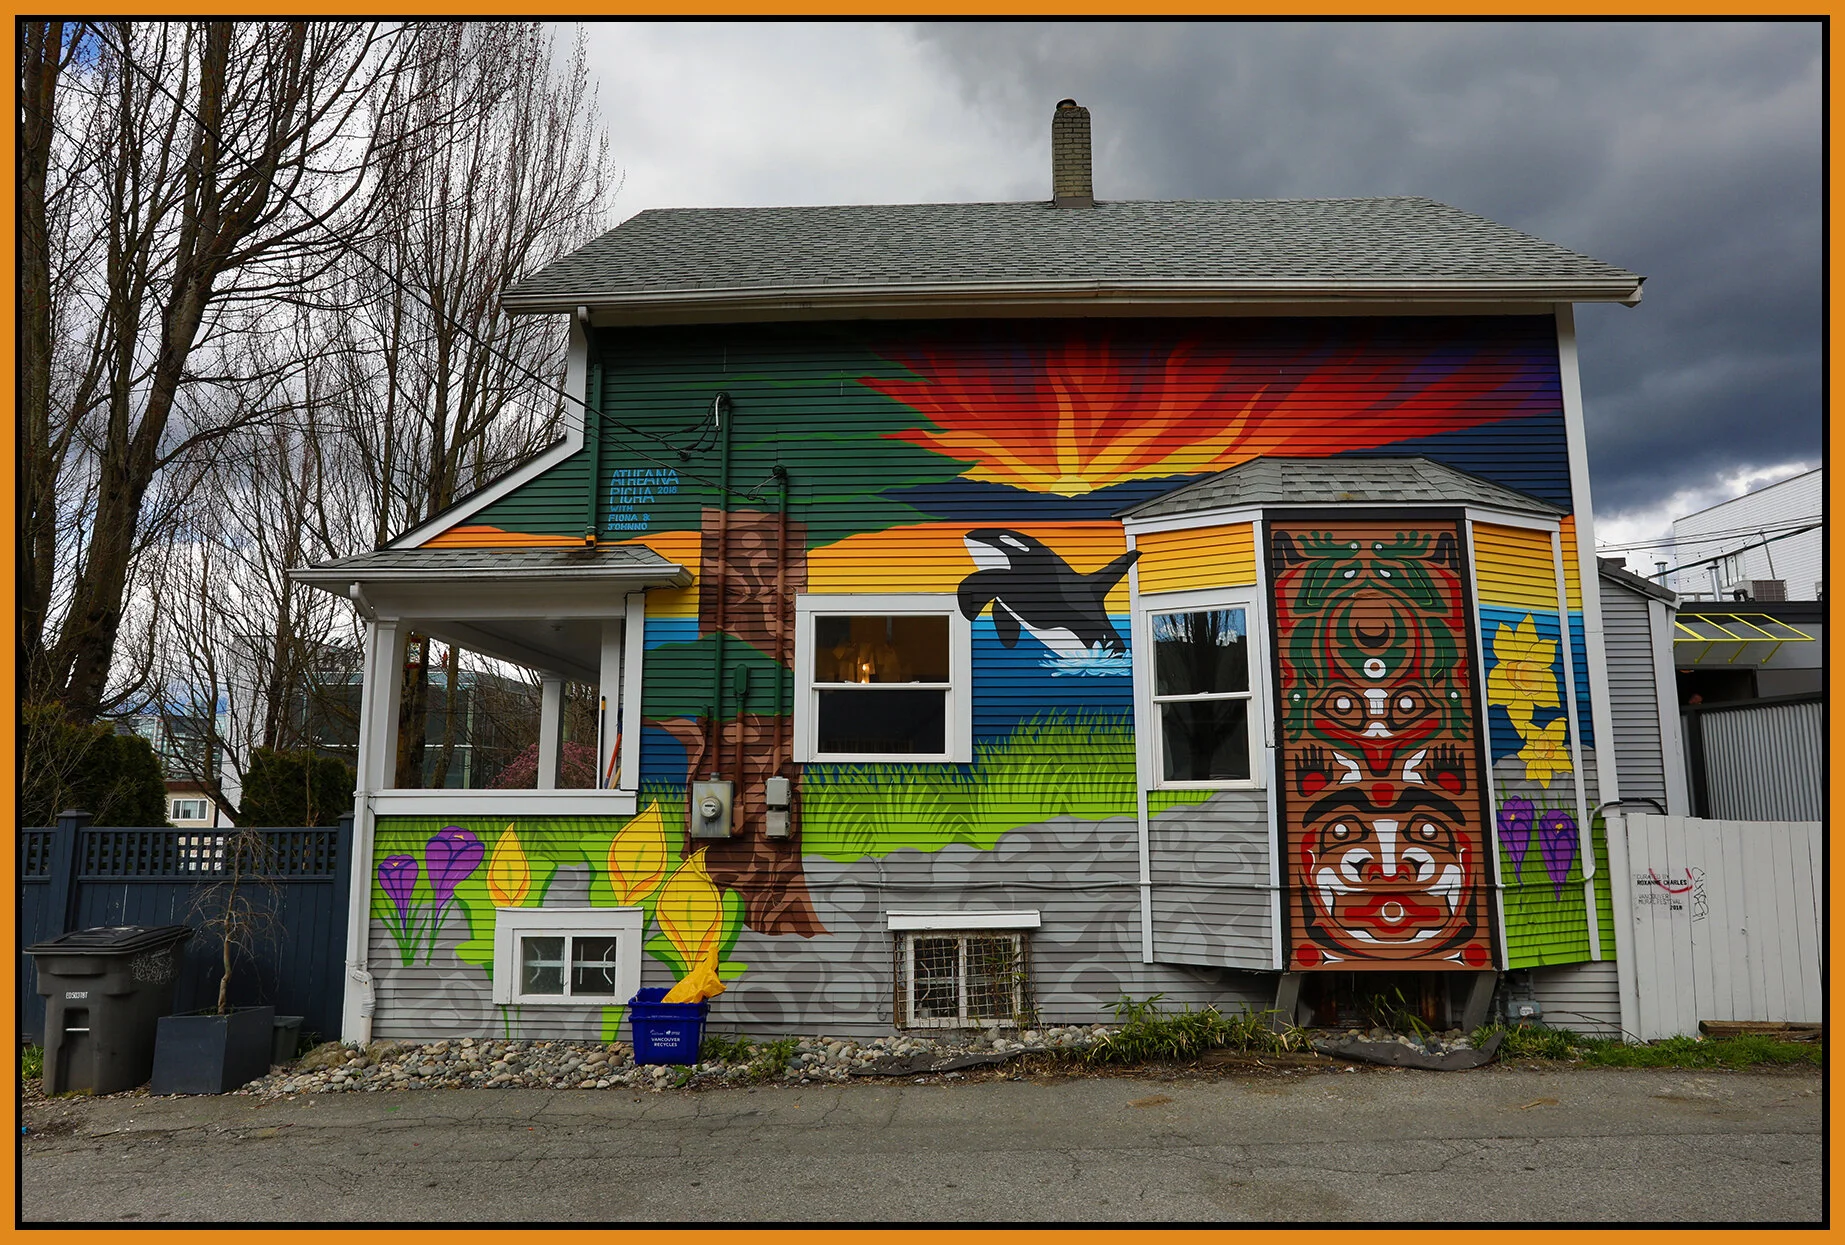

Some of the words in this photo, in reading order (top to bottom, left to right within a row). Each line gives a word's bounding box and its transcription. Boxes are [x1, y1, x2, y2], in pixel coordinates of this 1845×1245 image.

[610, 469, 680, 486] ATHEANA
[610, 487, 656, 504] PICHA
[657, 486, 678, 494] 2018
[608, 514, 638, 522] FIONA
[642, 514, 651, 522] &
[608, 522, 648, 530] JOHNNO
